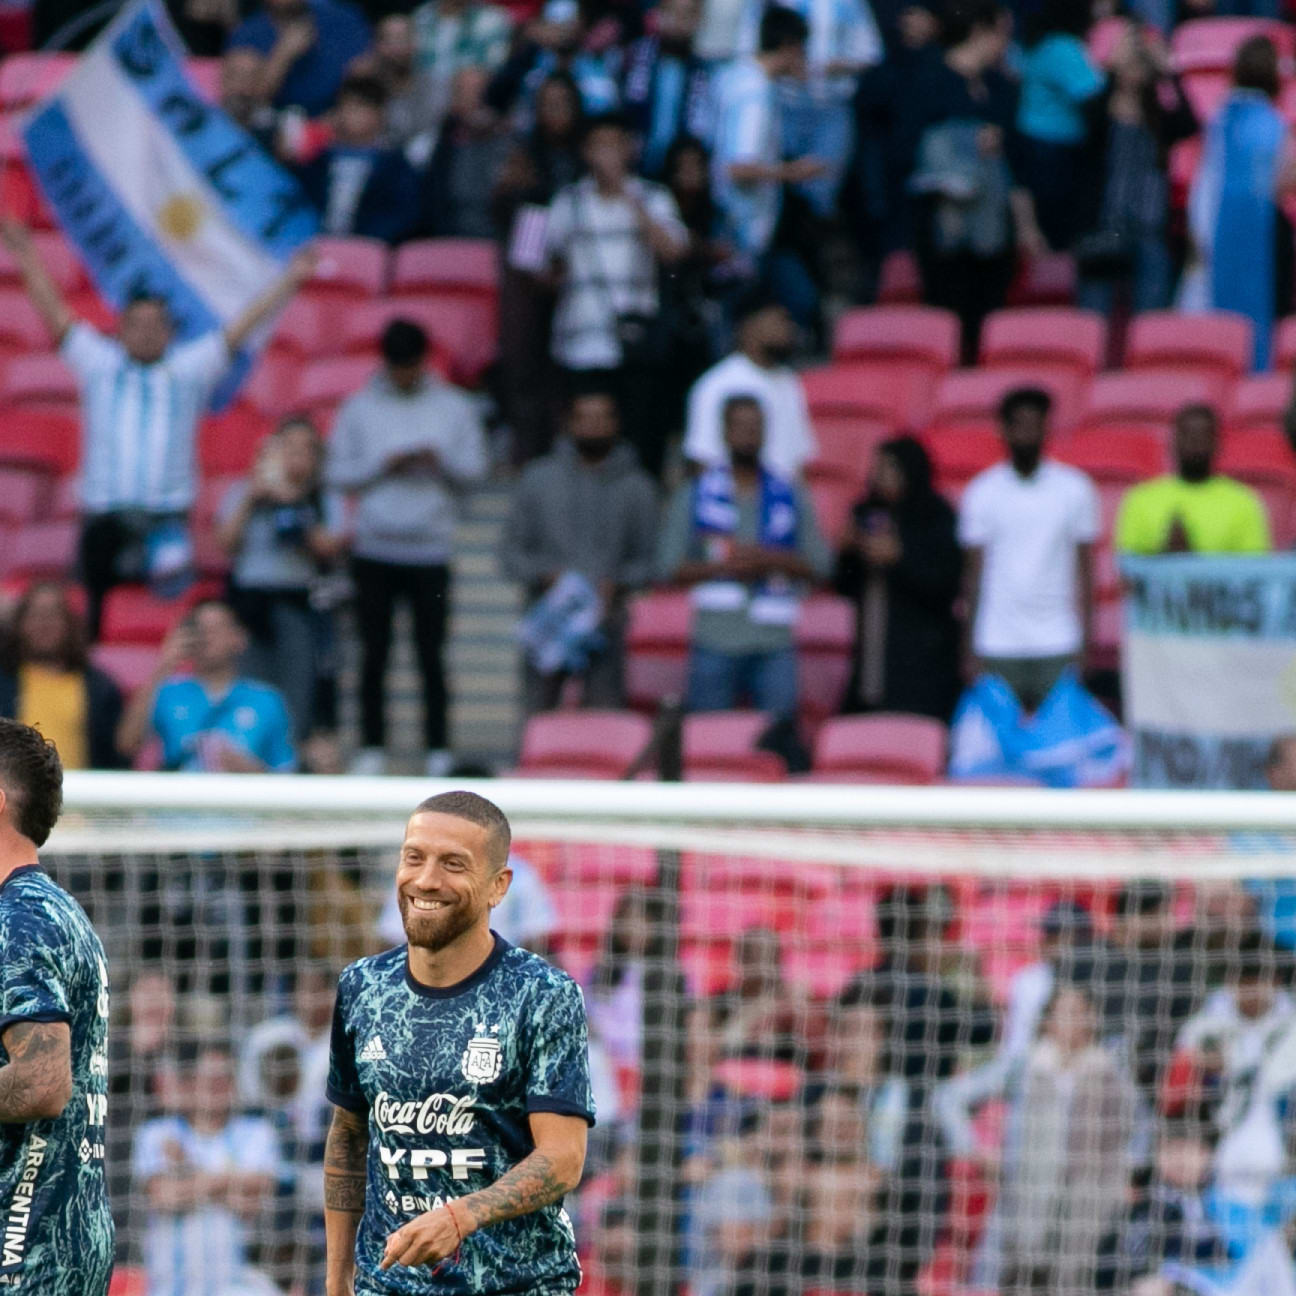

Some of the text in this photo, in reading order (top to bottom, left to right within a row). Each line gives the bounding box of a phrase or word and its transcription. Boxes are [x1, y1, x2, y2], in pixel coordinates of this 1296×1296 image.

[375, 1091, 477, 1135] Coca-Cola
[379, 1146, 486, 1180] YPF
[2, 1134, 47, 1266] ARGENTINA
